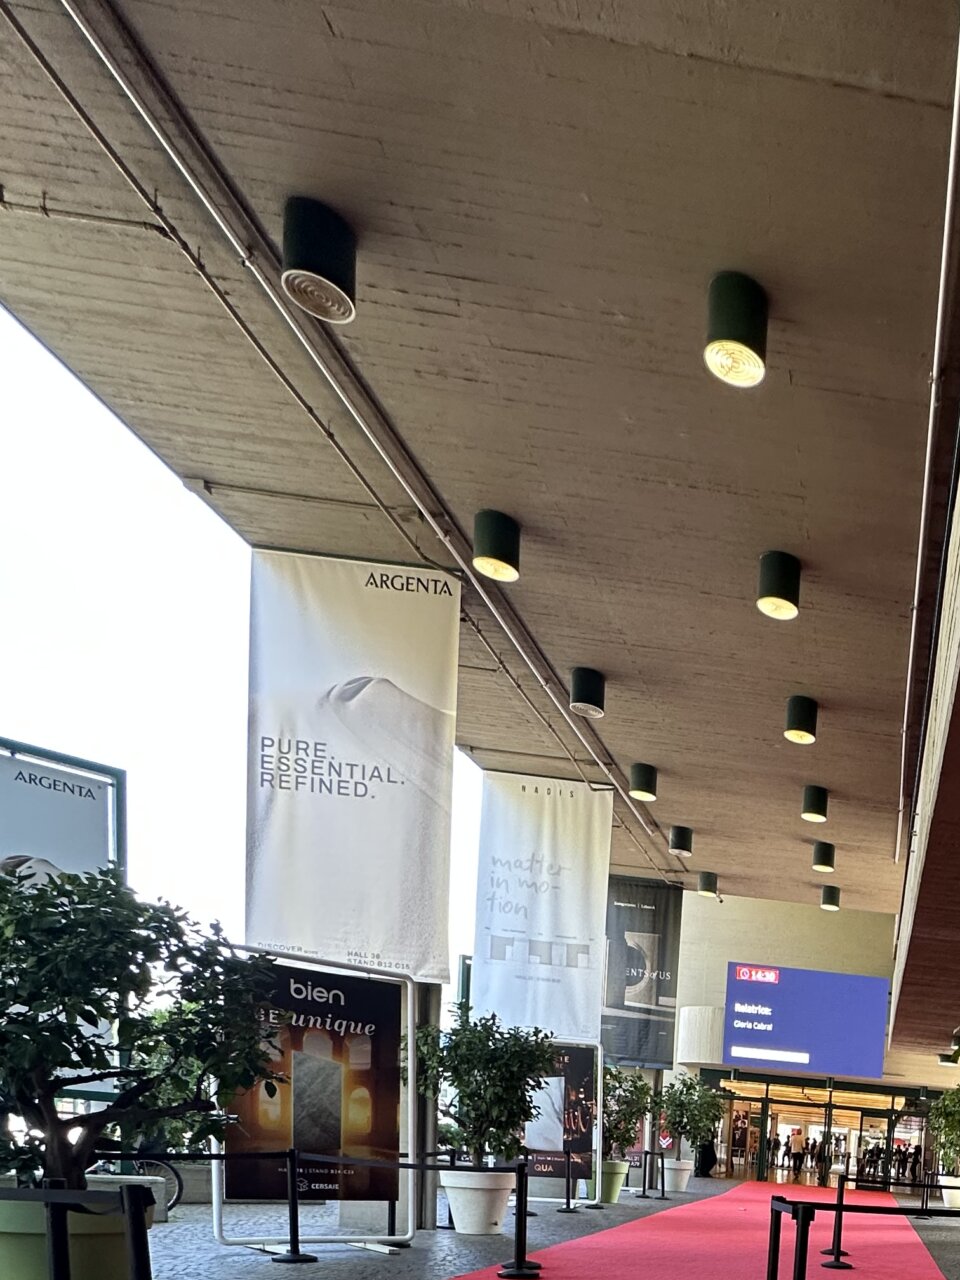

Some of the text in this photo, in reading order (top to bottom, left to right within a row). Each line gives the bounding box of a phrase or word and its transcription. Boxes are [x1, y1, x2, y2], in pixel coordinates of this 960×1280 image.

[365, 572, 453, 597] ARGENTA
[261, 736, 335, 761] PURE.
[260, 754, 405, 786] ESSENTIAL.
[14, 770, 97, 801] ARGENTA
[260, 772, 376, 800] REFINED.
[491, 852, 572, 876] matter
[490, 870, 510, 894] in
[486, 891, 528, 919] tion
[290, 977, 345, 1006] bien
[291, 1013, 376, 1036] unique
